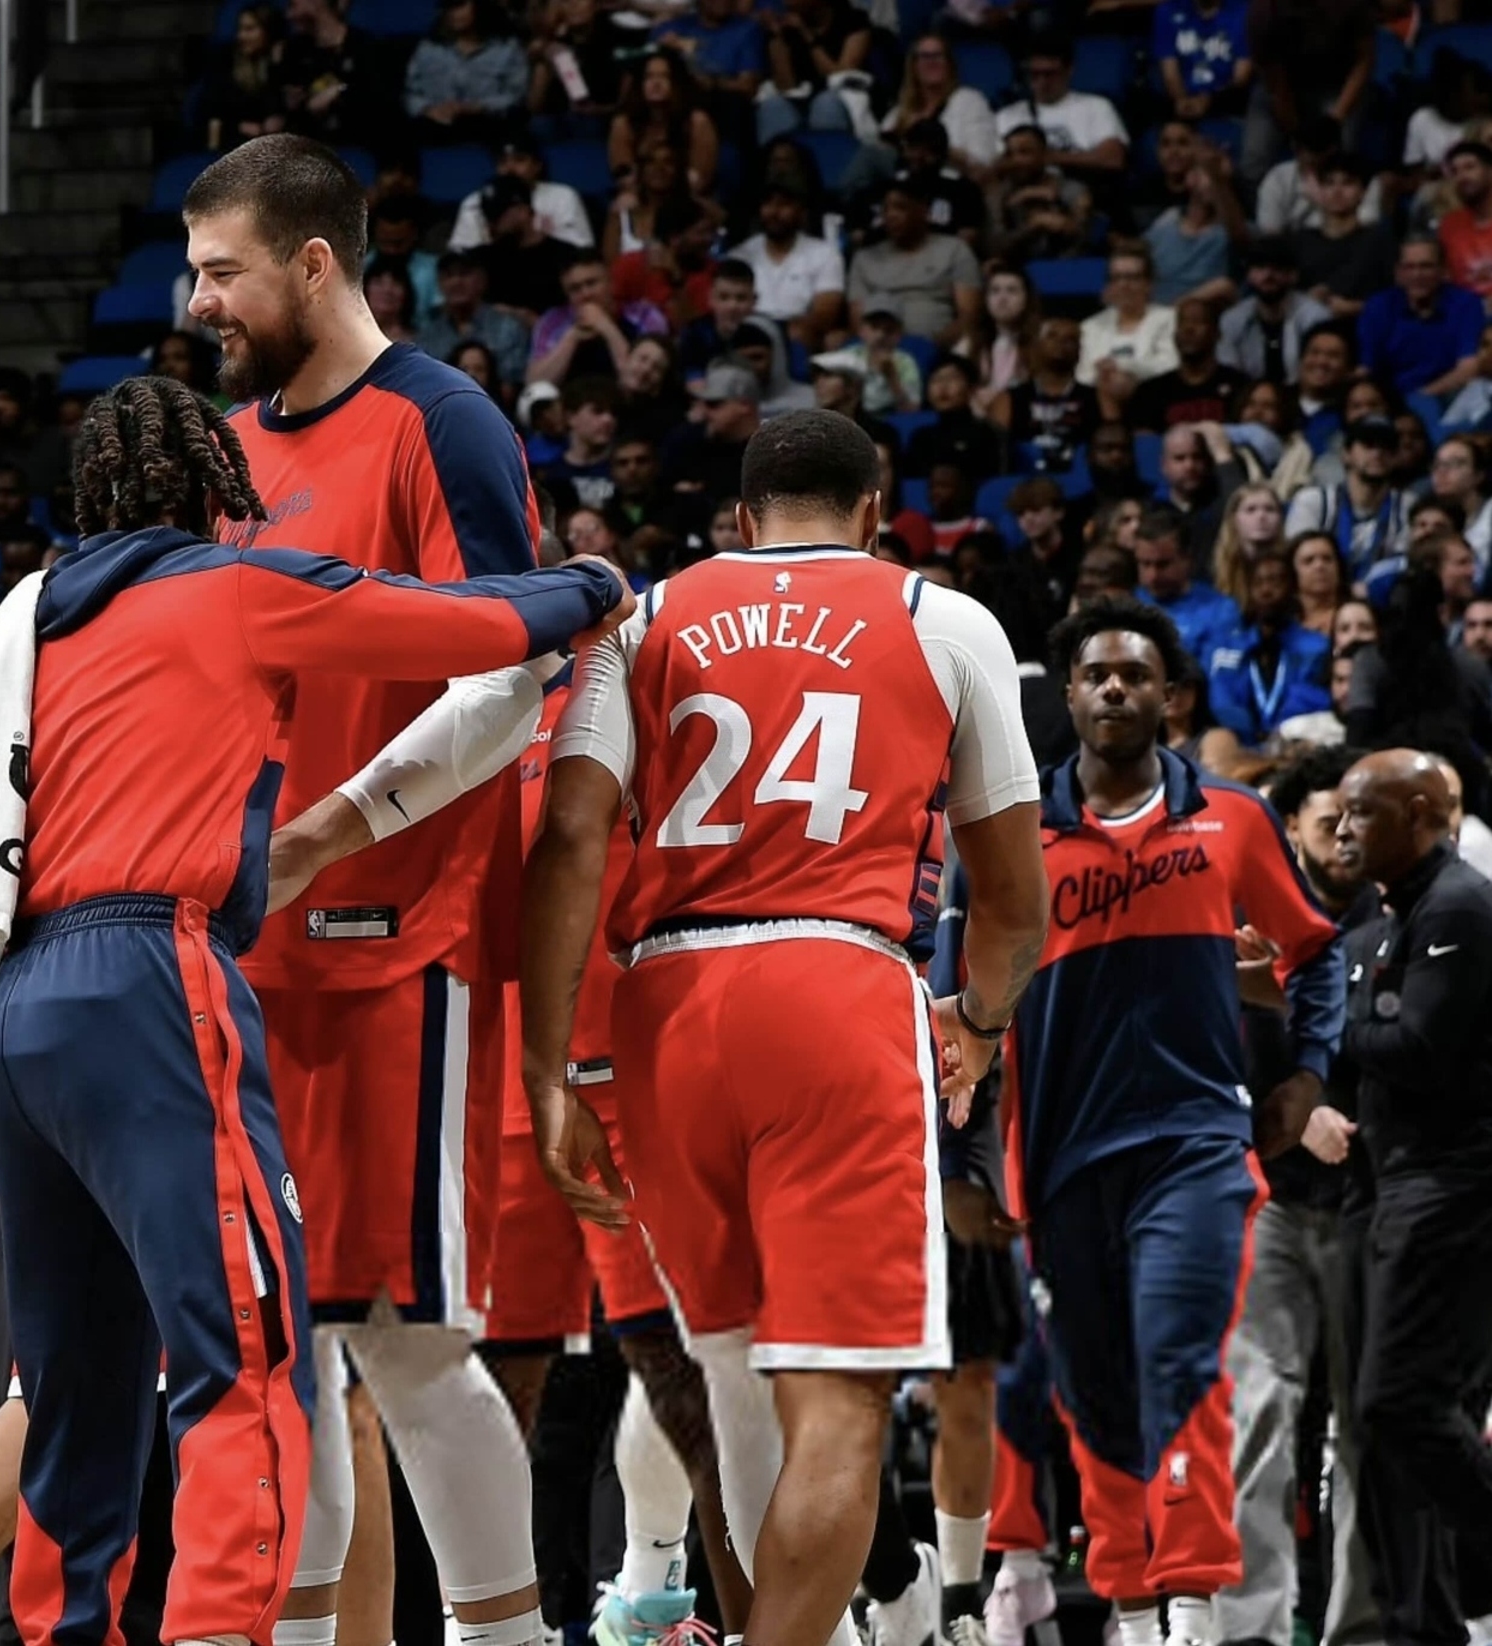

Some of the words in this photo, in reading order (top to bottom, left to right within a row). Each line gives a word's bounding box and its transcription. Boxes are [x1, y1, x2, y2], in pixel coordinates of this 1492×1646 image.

[677, 603, 867, 669] POWELL
[656, 691, 869, 848] 24
[1052, 843, 1210, 931] Clippers
